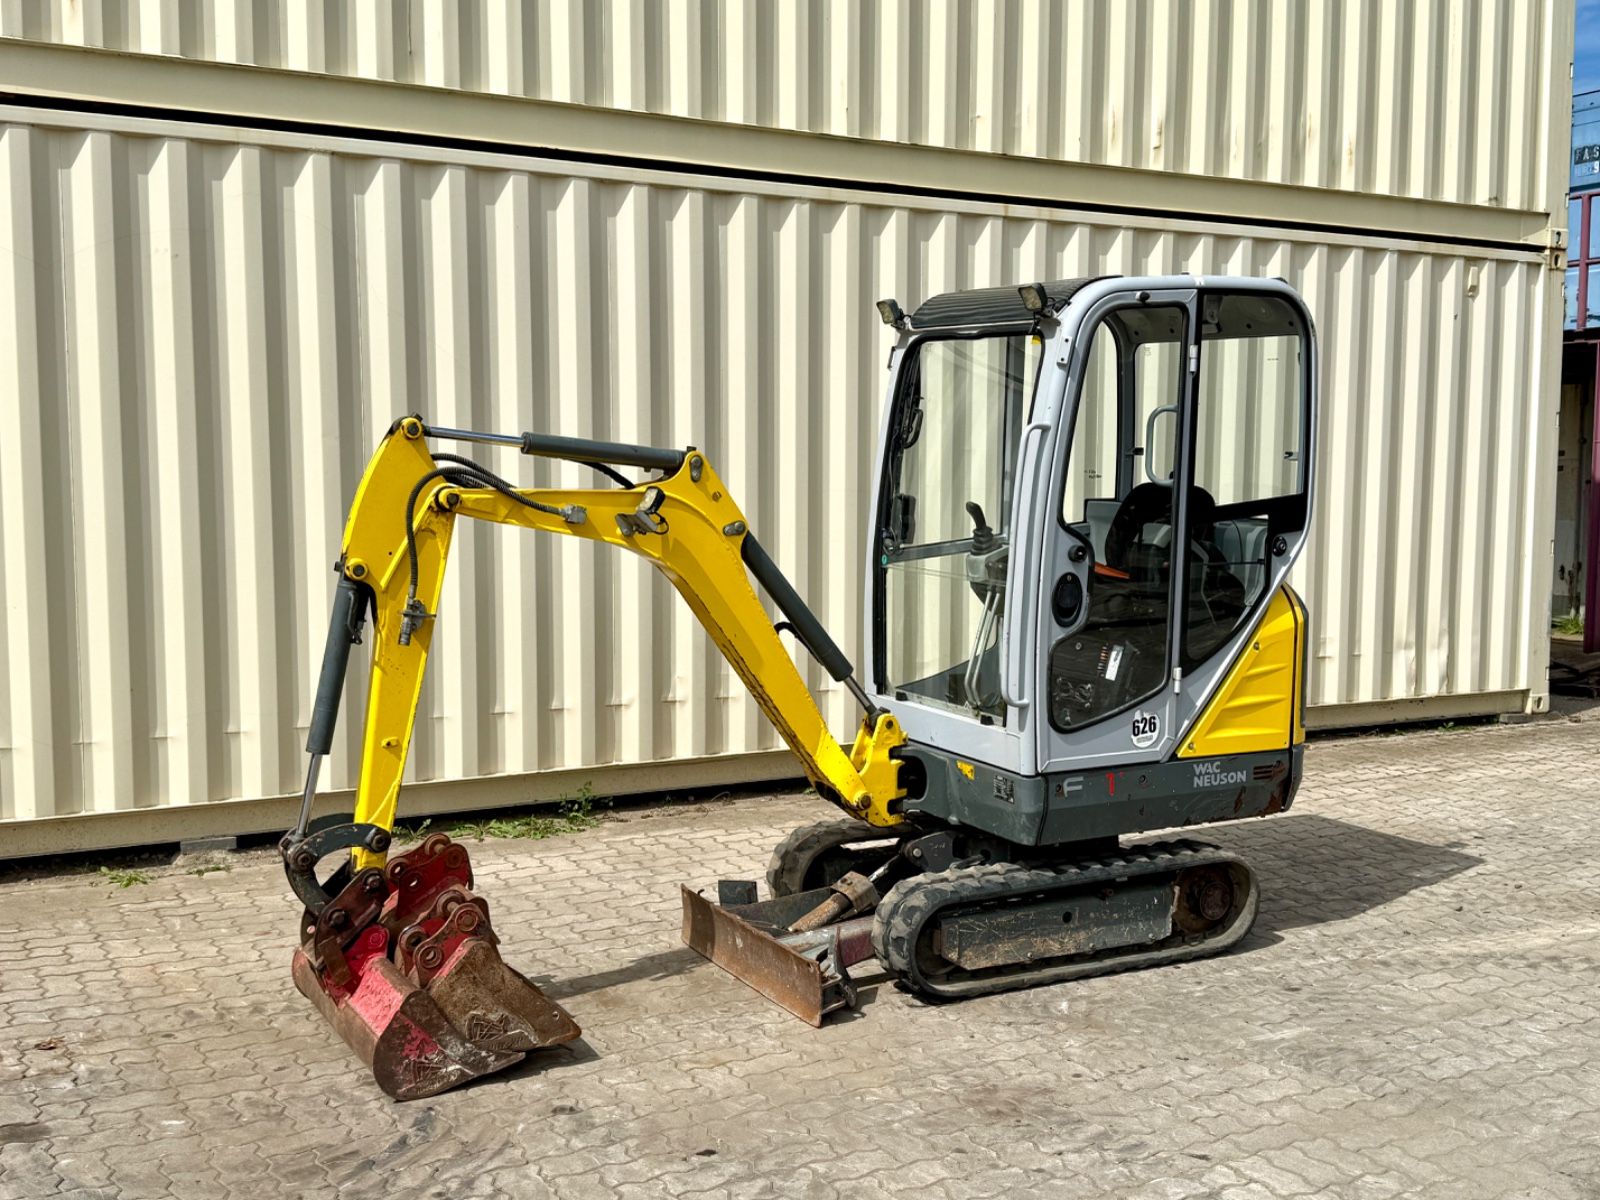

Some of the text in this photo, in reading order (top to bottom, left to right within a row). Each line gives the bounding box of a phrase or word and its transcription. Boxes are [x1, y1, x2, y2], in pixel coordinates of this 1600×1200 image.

[1132, 715, 1157, 737] 626
[1193, 761, 1221, 775] WAC
[1193, 770, 1247, 788] NEUSON
